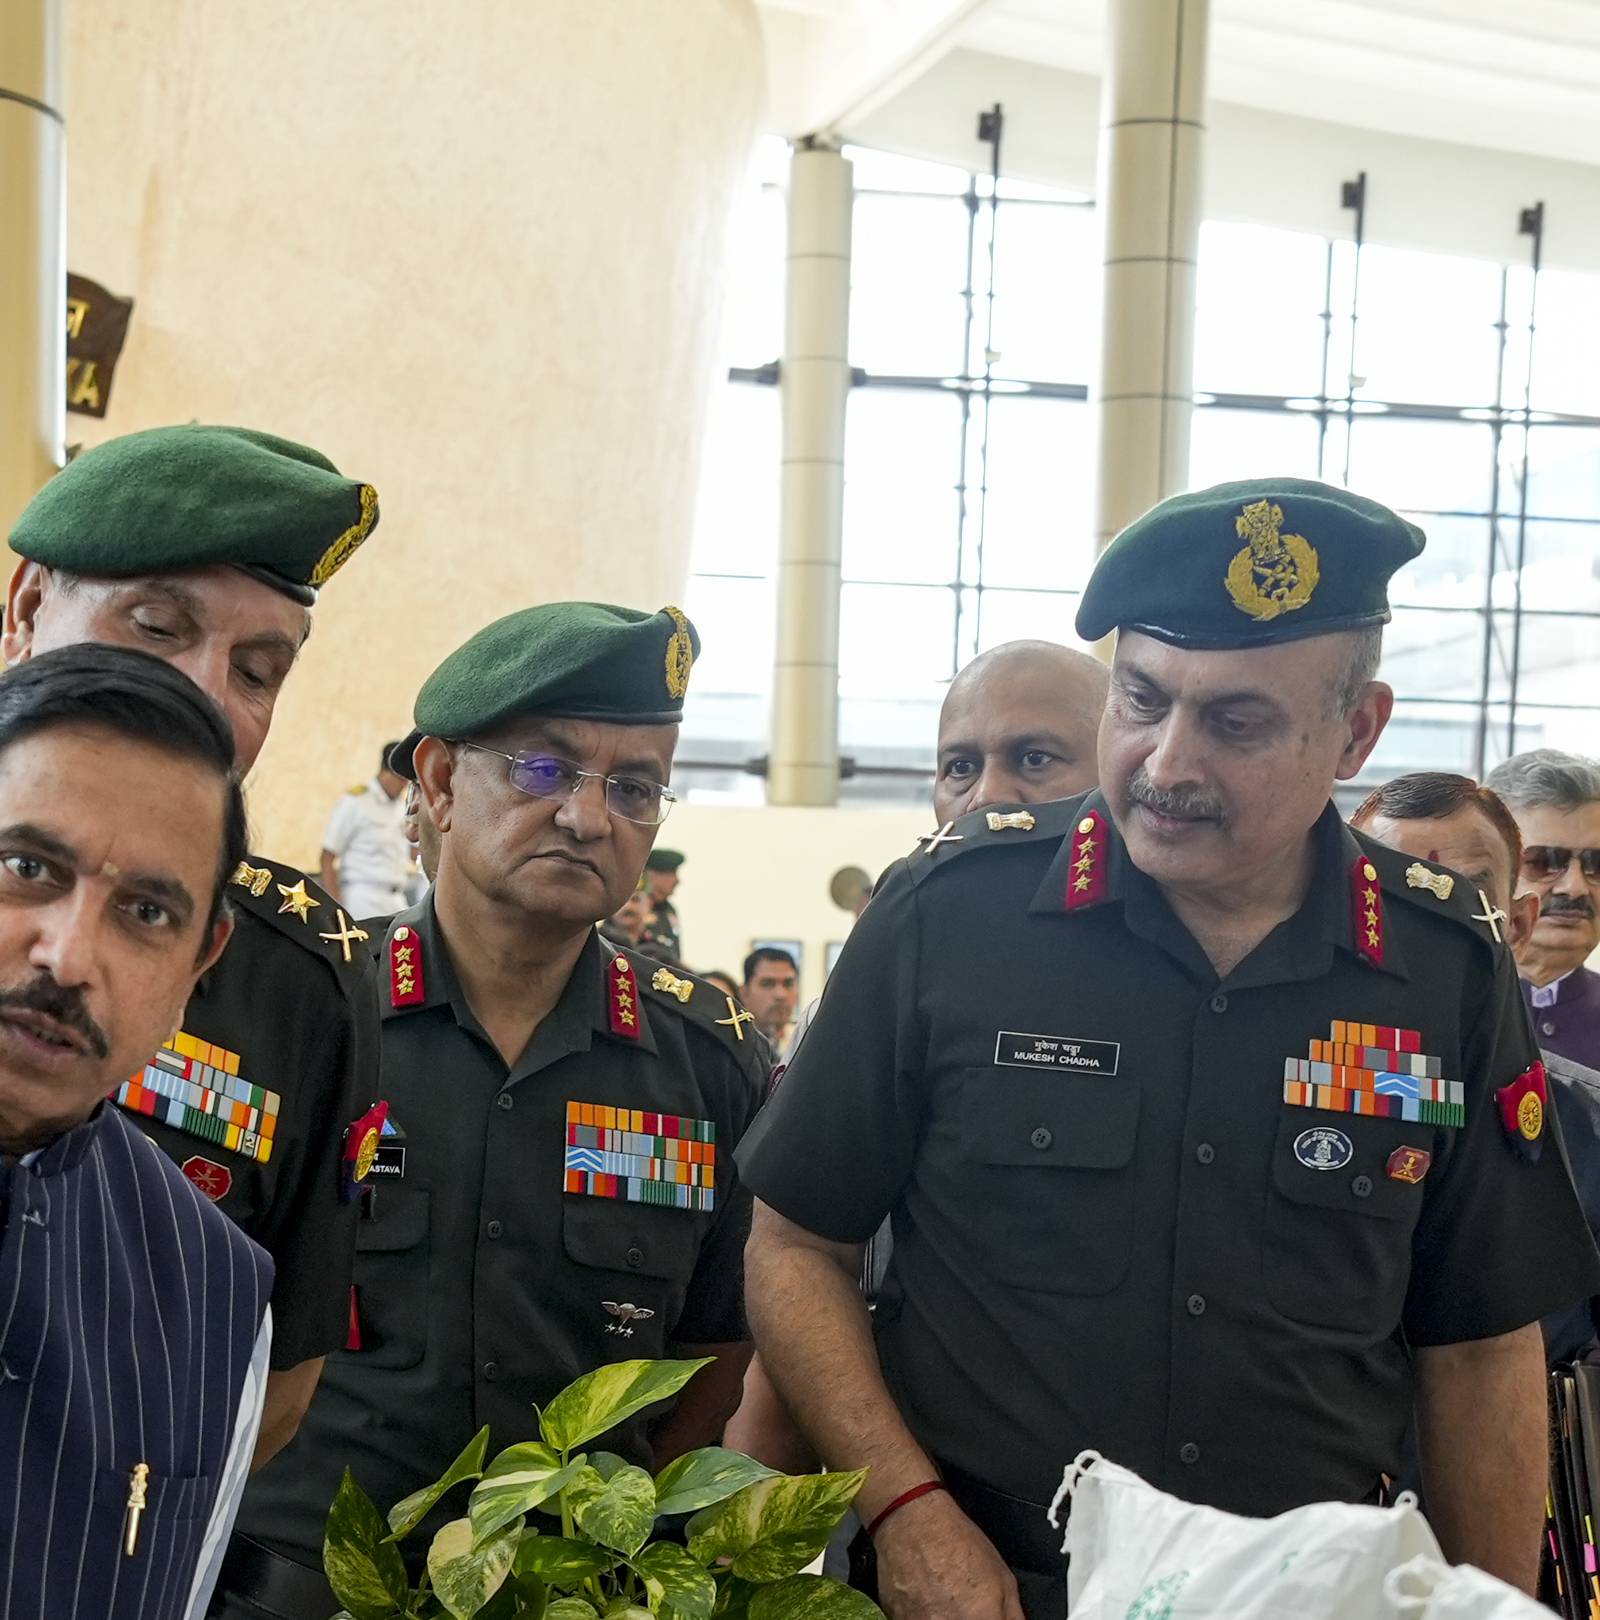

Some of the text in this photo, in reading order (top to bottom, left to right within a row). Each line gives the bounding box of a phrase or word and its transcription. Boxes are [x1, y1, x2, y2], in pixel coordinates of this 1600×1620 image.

[1013, 1051, 1101, 1068] MUKESH CHADHA
[368, 1164, 401, 1174] ASTAVA
